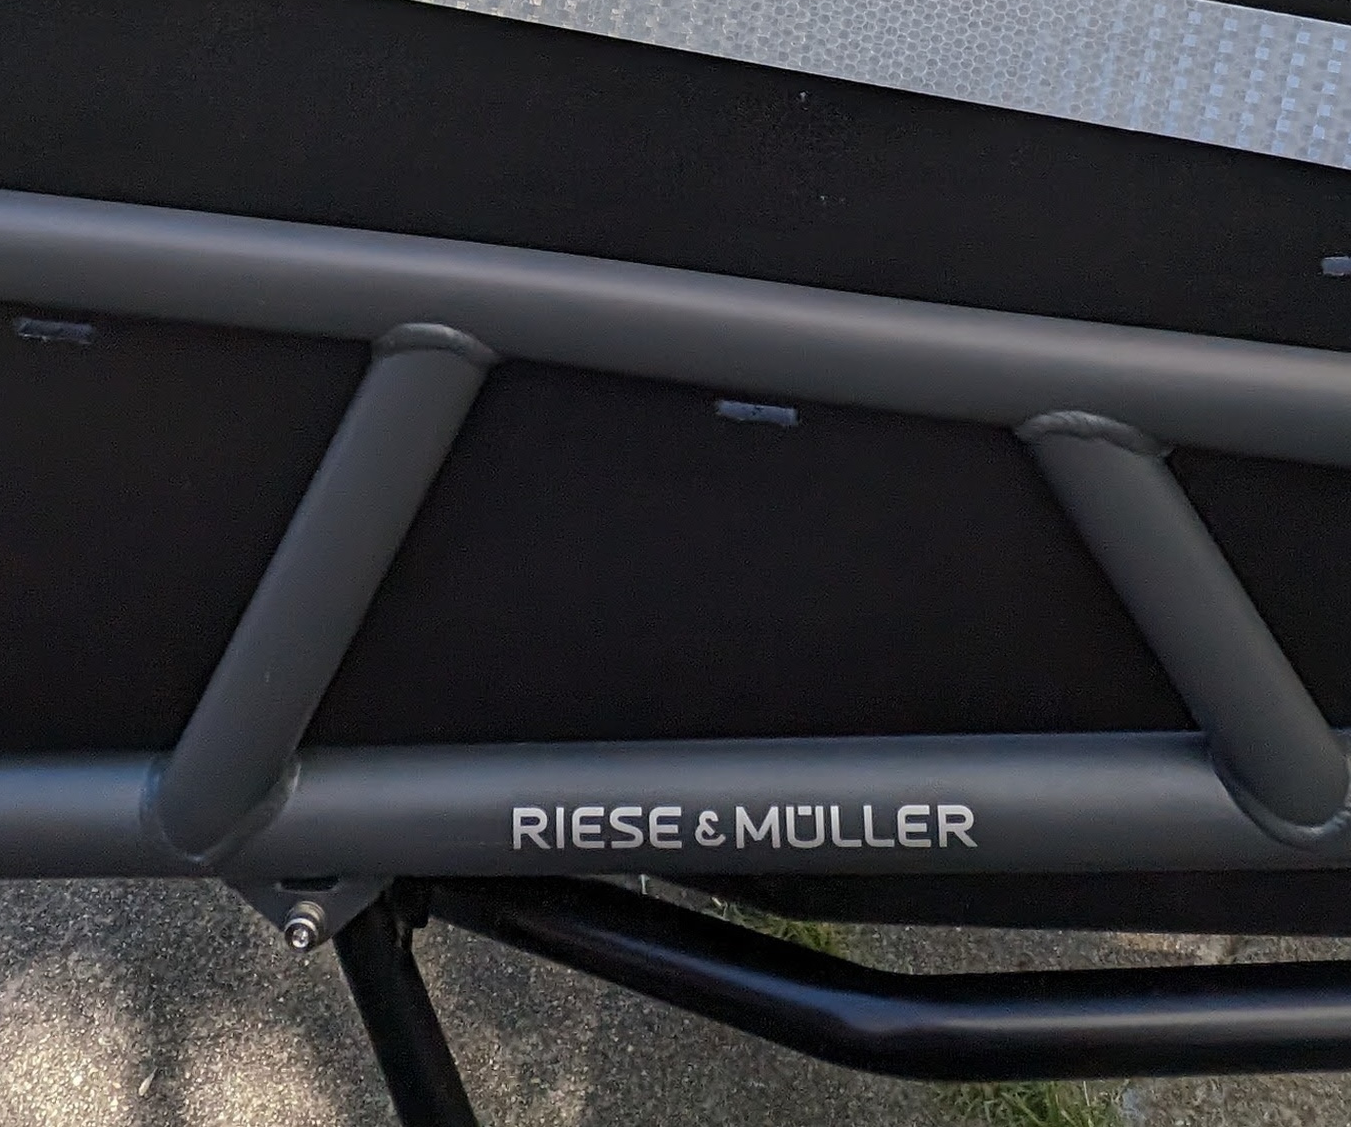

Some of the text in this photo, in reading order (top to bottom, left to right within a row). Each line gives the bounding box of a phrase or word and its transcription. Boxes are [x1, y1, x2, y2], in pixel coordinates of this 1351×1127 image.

[512, 804, 978, 850] RIESE & MÜLLER
